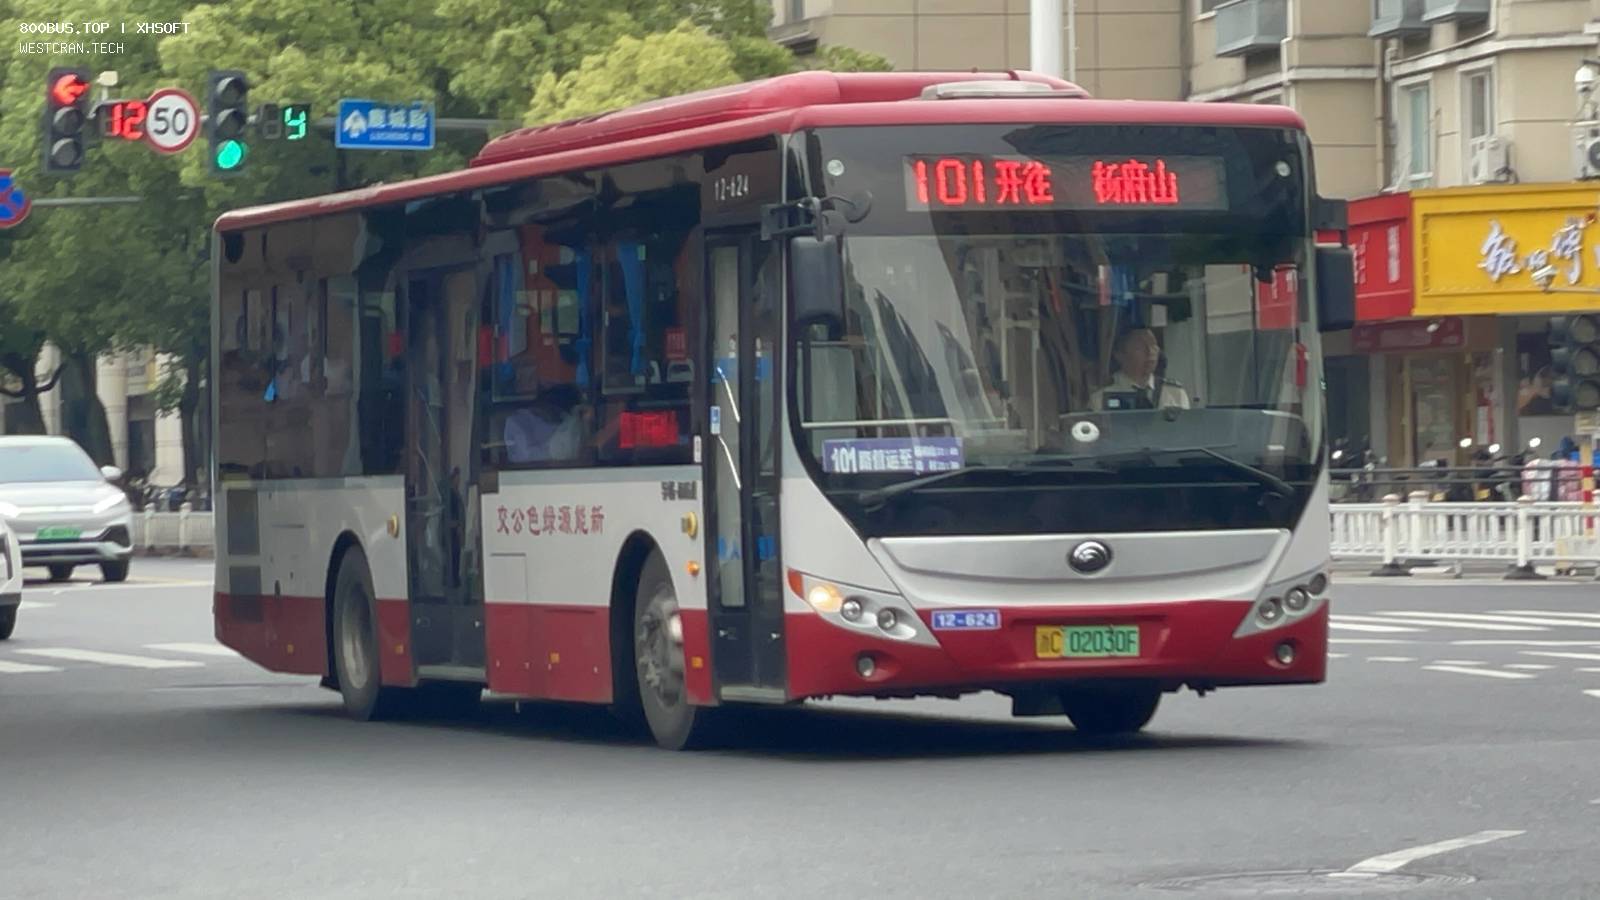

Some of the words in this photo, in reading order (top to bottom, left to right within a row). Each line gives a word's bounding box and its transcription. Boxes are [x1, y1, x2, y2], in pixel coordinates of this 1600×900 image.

[111, 101, 147, 140] 12
[153, 107, 189, 136] 50
[1091, 158, 1179, 205] 杨府山
[937, 612, 996, 627] 12-624
[1069, 629, 1138, 654] 02030F
